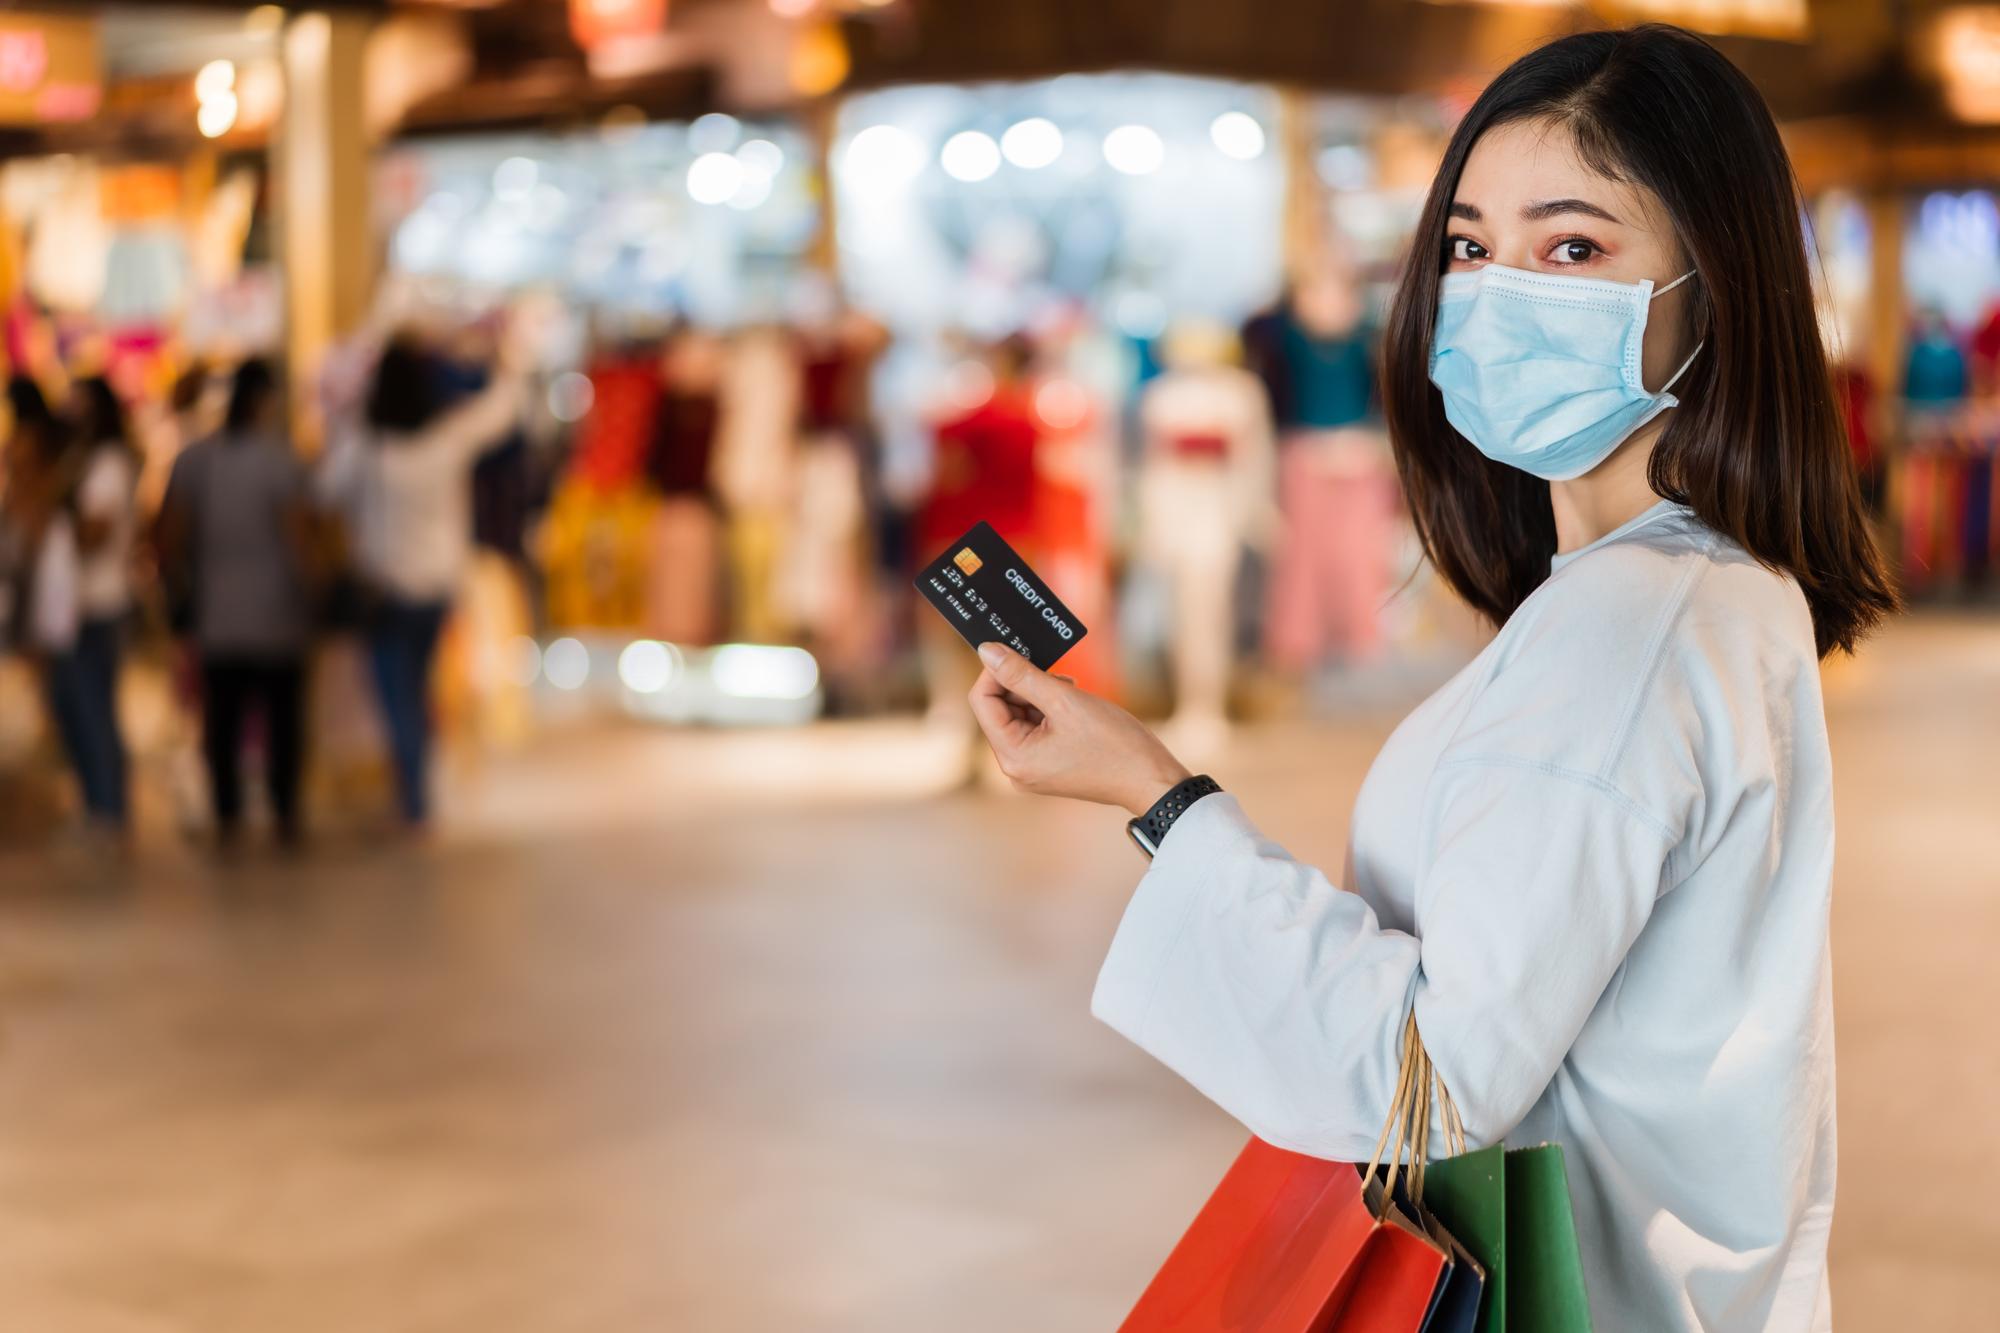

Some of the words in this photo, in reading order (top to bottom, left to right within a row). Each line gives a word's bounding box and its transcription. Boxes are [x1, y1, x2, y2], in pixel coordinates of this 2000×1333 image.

[942, 566, 964, 588] 1234
[965, 588, 988, 612] 5678
[989, 613, 1010, 636] 9012
[1005, 568, 1045, 608] CREDIT
[1041, 607, 1073, 640] CARD
